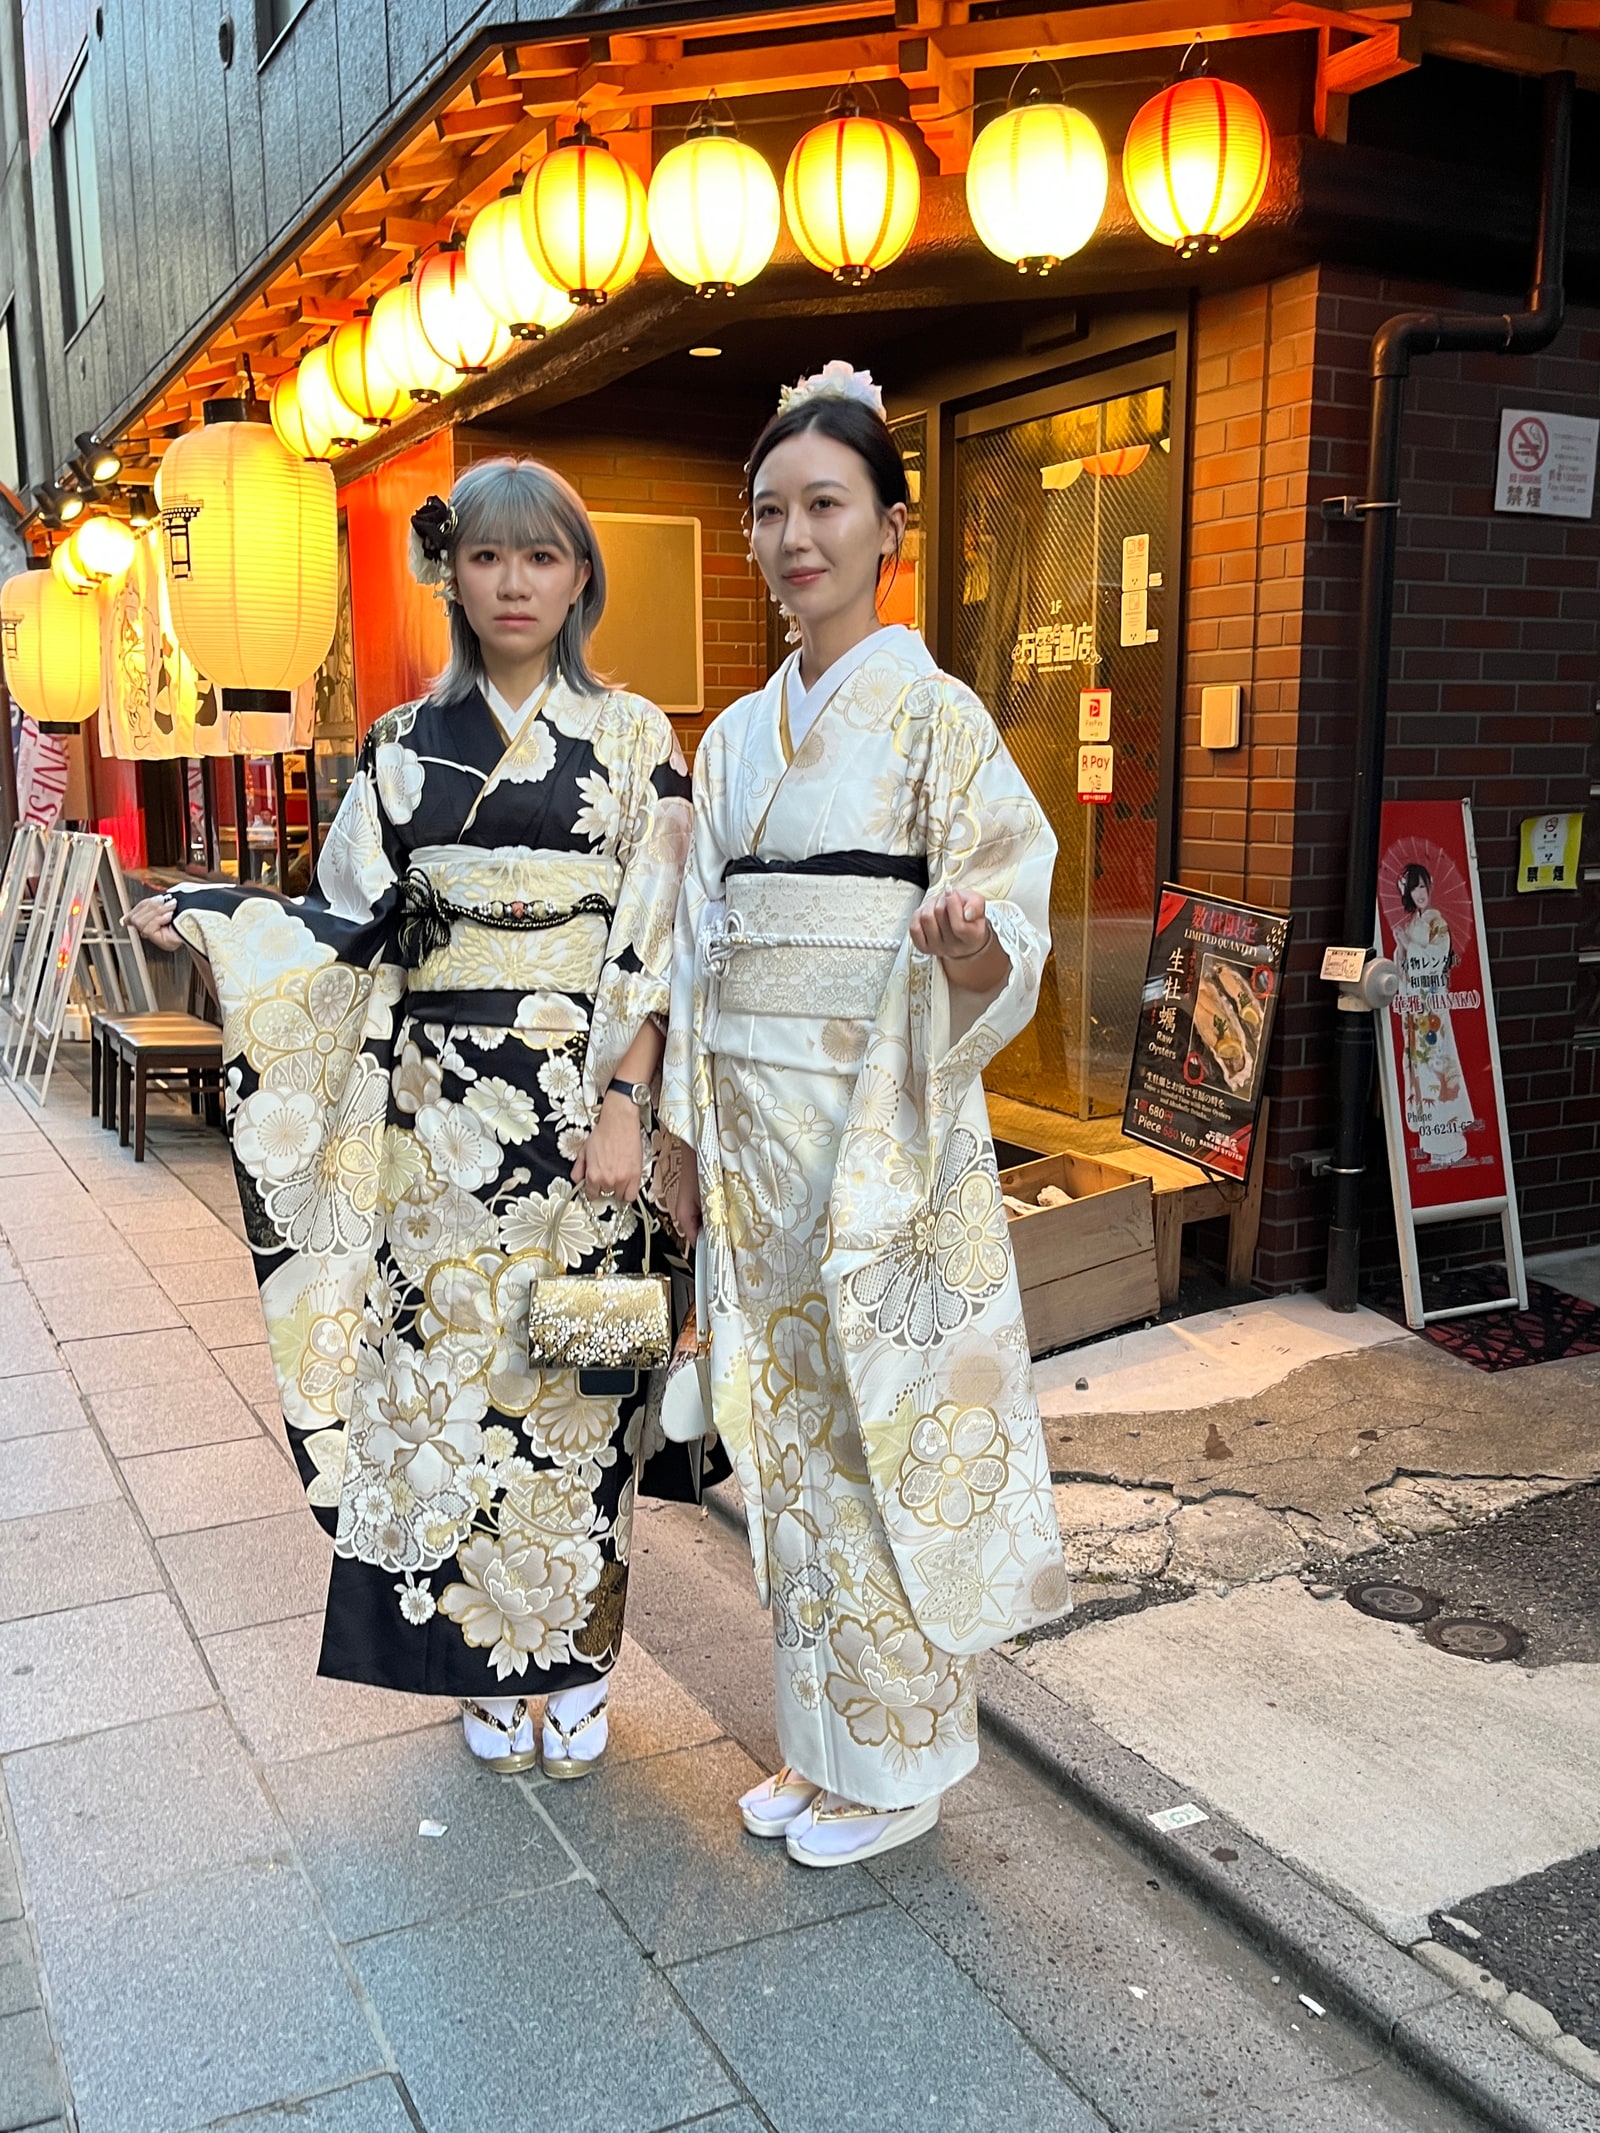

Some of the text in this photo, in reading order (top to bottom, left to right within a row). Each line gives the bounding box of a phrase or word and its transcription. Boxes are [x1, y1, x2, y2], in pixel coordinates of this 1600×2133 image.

[1050, 600, 1062, 614] 1F
[1090, 755, 1110, 771] Pay
[1191, 904, 1258, 943] 数量限定
[1184, 928, 1257, 957] LIMITED QUANTITY
[1158, 947, 1185, 1034] 生牡蠣
[1156, 1030, 1173, 1045] Raw
[1148, 1042, 1177, 1060] Oysters
[1407, 1112, 1432, 1123] Phone
[1138, 1115, 1162, 1134] Piece
[1180, 1132, 1196, 1148] Yen
